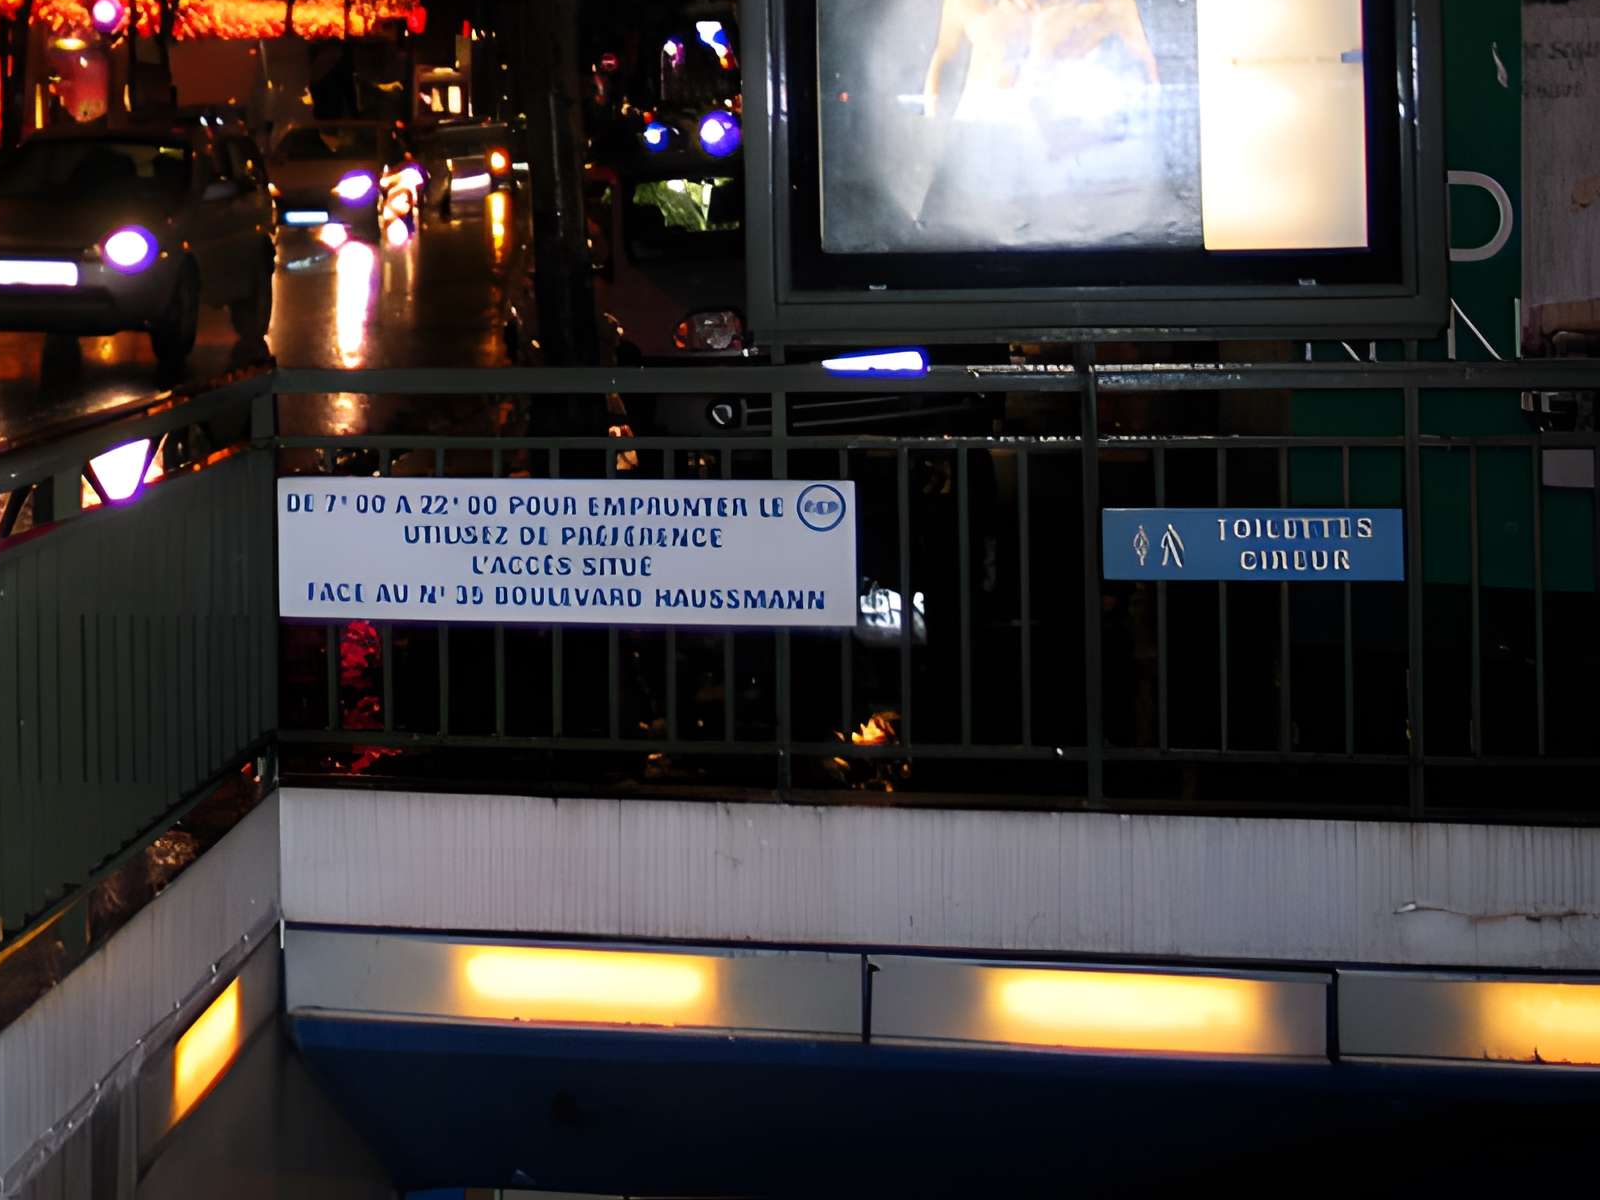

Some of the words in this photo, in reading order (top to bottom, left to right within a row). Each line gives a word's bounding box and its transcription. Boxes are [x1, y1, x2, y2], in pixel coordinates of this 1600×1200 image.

[509, 495, 578, 516] POUR
[375, 582, 409, 603] AU
[654, 588, 826, 610] HAUSSMANN
